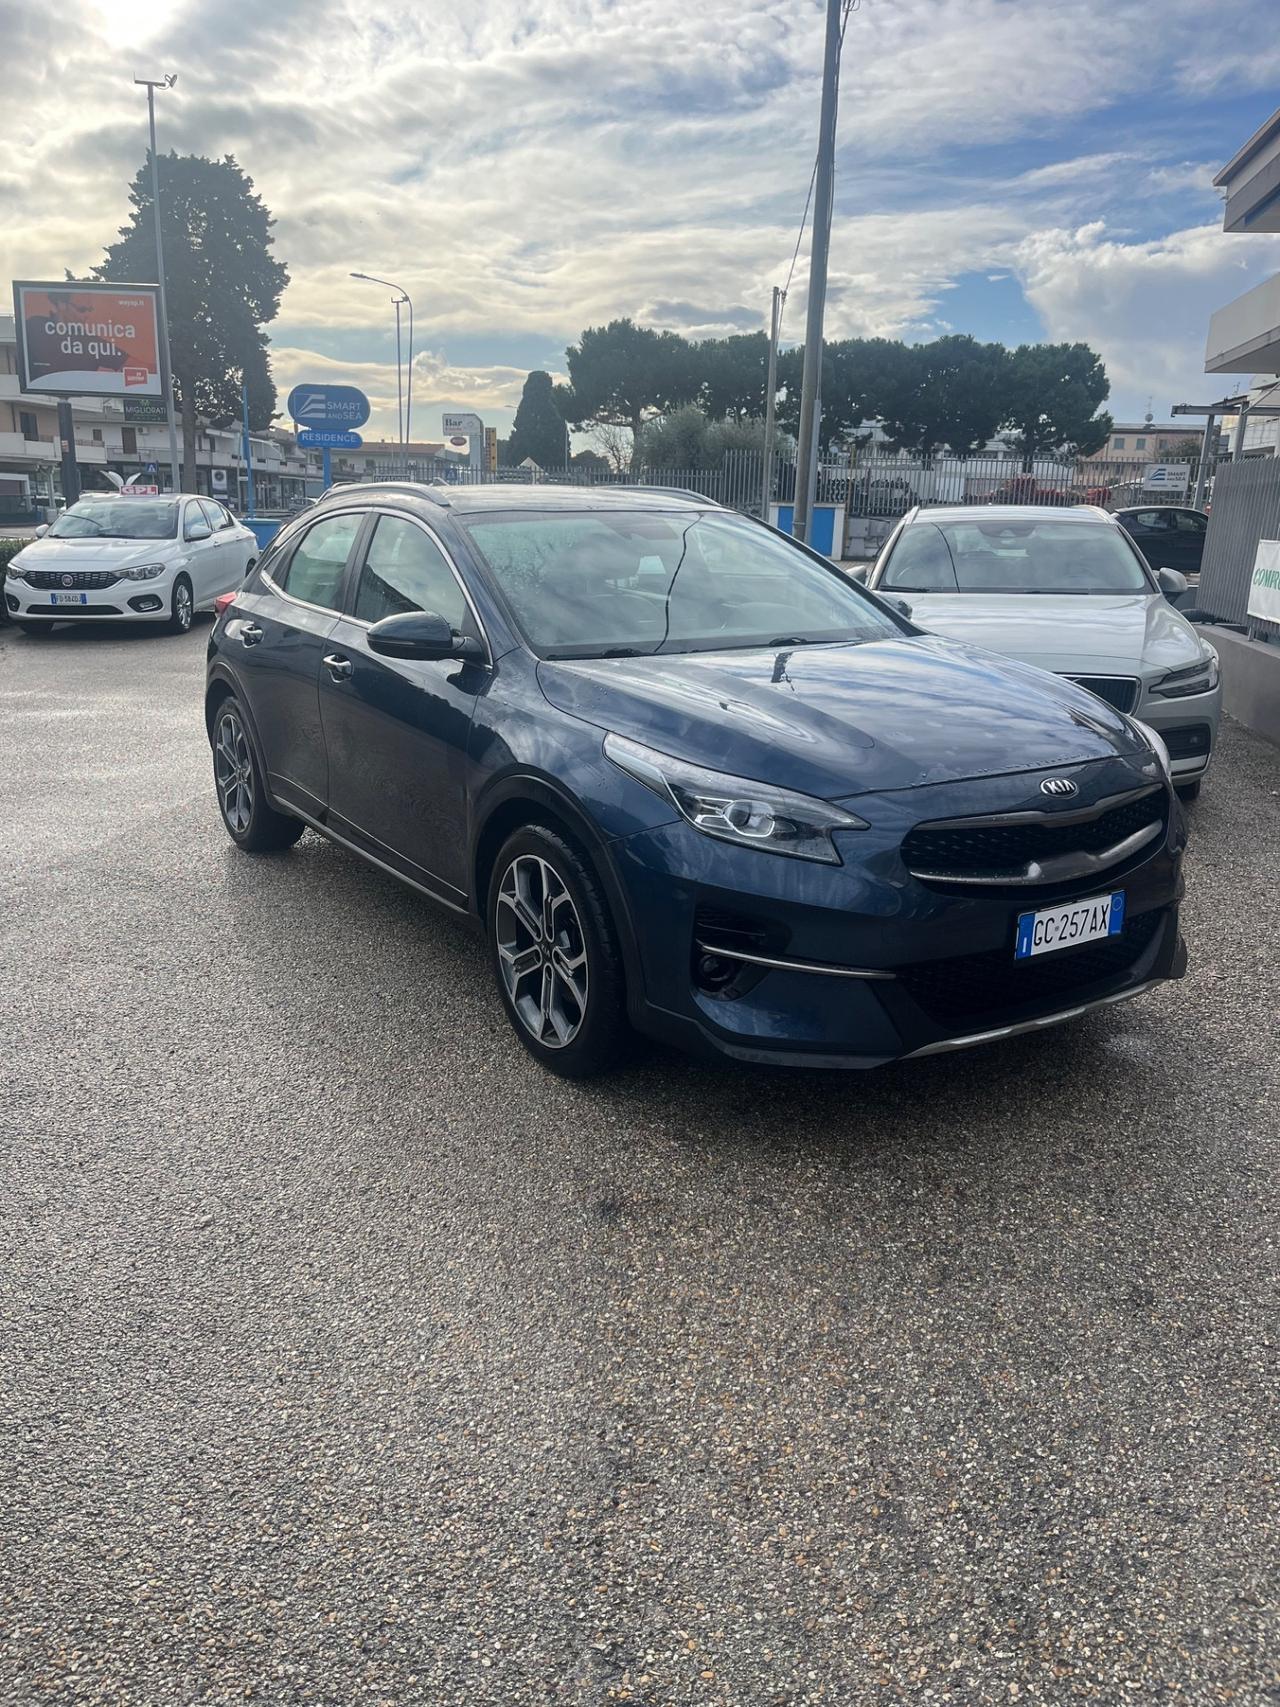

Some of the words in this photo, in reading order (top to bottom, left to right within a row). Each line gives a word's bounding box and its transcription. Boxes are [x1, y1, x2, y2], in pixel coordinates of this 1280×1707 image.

[44, 319, 136, 338] comunica
[60, 336, 84, 355] da
[87, 338, 122, 360] qui.
[125, 406, 166, 415] MIGLIORATI
[327, 401, 361, 411] SMART
[445, 418, 463, 427] Bar
[301, 432, 357, 443] RESIDENCE
[121, 485, 157, 495] GPL
[1046, 778, 1075, 794] KIA
